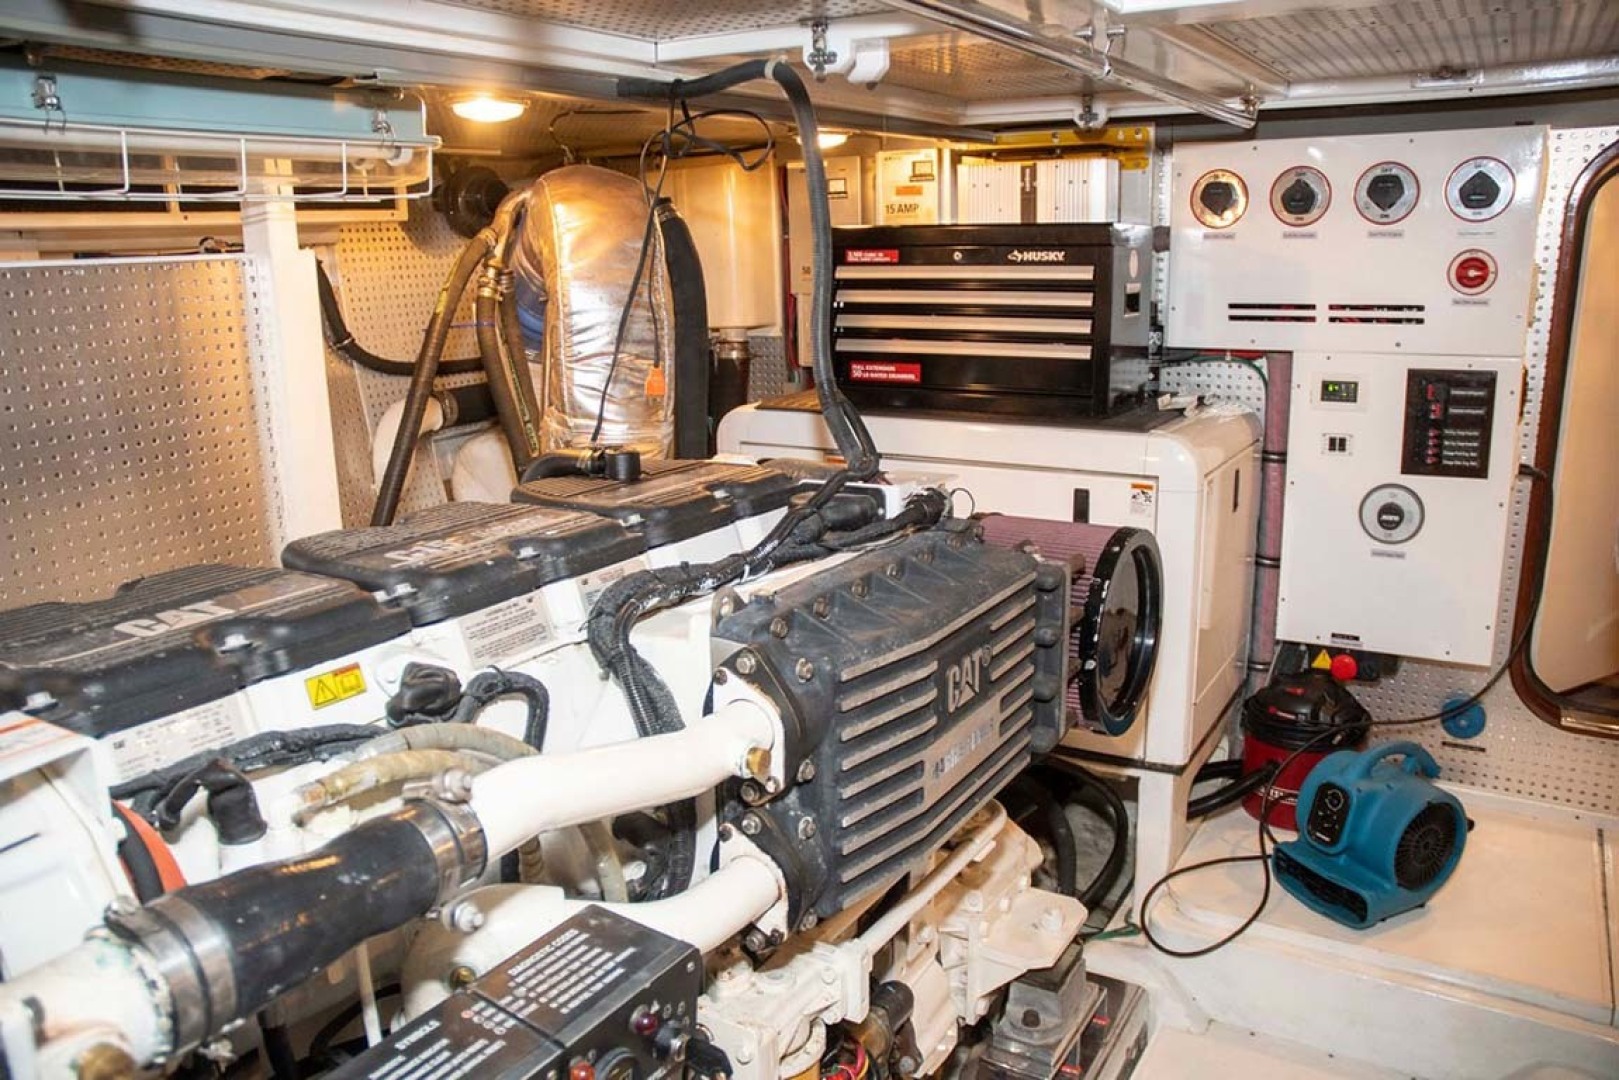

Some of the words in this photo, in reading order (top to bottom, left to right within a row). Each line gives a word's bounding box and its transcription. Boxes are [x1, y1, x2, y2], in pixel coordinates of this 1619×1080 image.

[885, 203, 896, 215] 15
[897, 203, 920, 214] AMP
[1023, 250, 1066, 262] HUSKY
[113, 600, 236, 638] CAT
[946, 648, 982, 714] CAT
